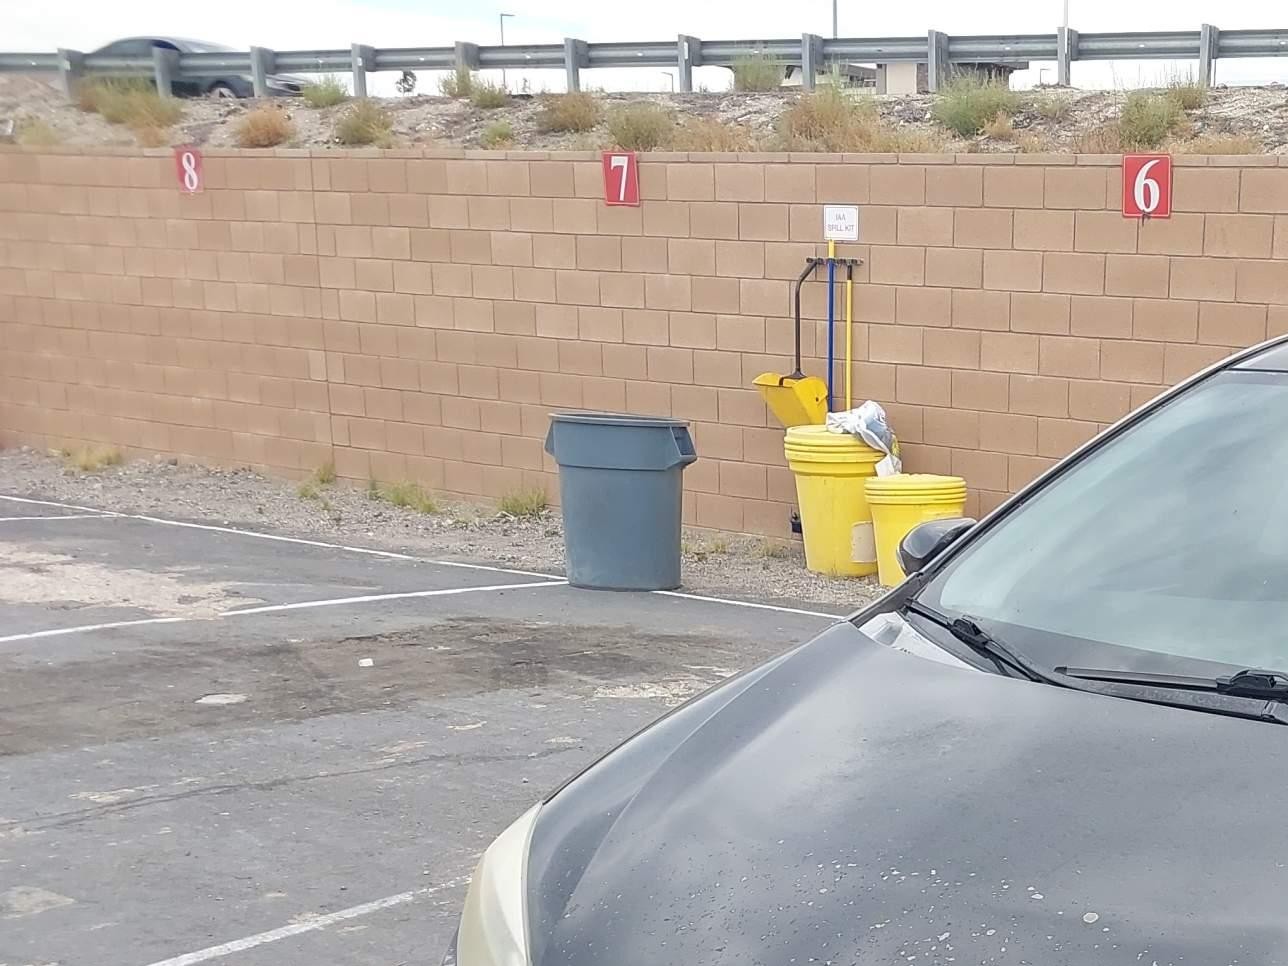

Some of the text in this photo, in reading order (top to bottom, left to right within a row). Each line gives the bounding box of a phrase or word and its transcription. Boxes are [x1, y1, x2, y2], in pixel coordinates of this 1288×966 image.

[182, 152, 198, 190] 8
[611, 156, 629, 201] 7
[1134, 159, 1161, 213] 6
